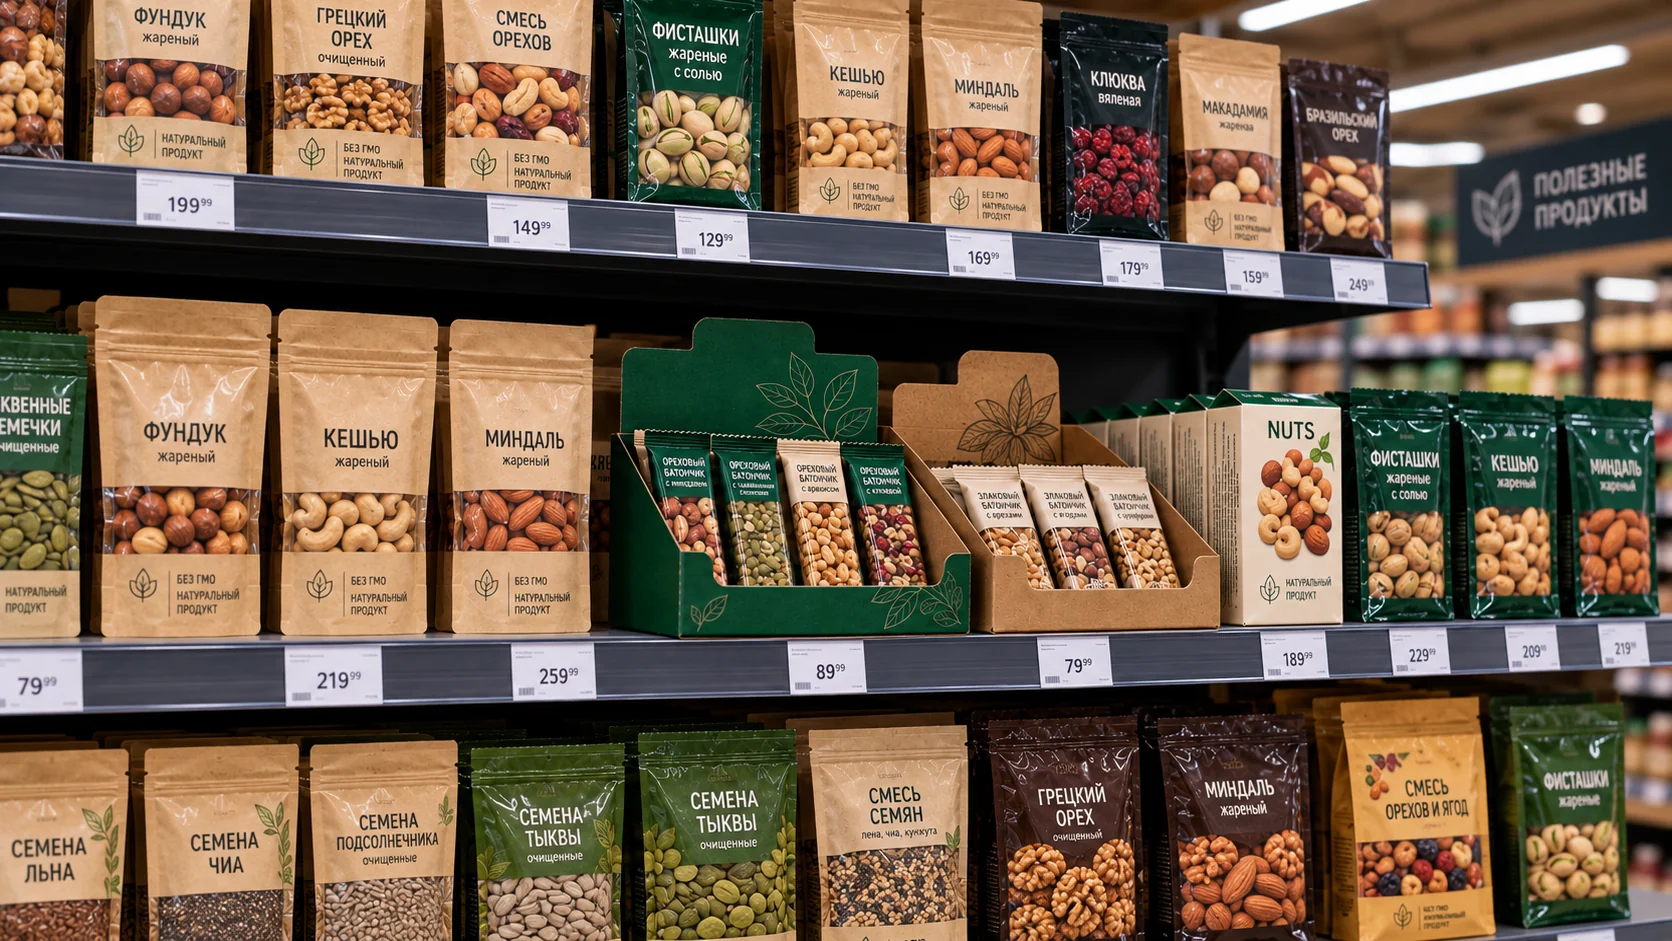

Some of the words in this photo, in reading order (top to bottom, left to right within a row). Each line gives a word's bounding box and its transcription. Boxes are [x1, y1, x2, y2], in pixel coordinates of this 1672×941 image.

[134, 7, 206, 29] ФУНДУК
[317, 7, 386, 29] ГРЕЦКИЙ
[496, 10, 547, 30] СМЕСЬ
[142, 32, 199, 46] жареный
[331, 30, 372, 49] ОРЕХ
[493, 31, 552, 50] ОРЕХОВ
[652, 21, 739, 47] ФИСТАШКИ
[318, 52, 385, 68] очищенный
[668, 48, 727, 64] жареные
[675, 69, 681, 78] с
[684, 68, 722, 81] солью
[830, 65, 884, 86] КЕШЬЮ
[1091, 70, 1146, 91] КЛЮКВА
[838, 87, 879, 100] жареный
[954, 78, 1019, 98] МИНДАЛЬ
[969, 101, 1009, 112] жареный
[1098, 93, 1141, 107] вяленая
[1202, 100, 1268, 120] МАКАДАМИЯ
[1306, 108, 1377, 129] БРАЗИЛЬСКИЙ
[162, 133, 226, 149] НАТУРАЛЬНЫЙ
[1332, 127, 1359, 143] ОРЕХ
[161, 147, 203, 160] ПРОДУКТ
[344, 143, 359, 154] БЕЗ
[362, 144, 381, 154] ГМО
[344, 157, 404, 170] НАТУРАЛЬНЫЙ
[514, 153, 529, 163] БЕЗ
[532, 154, 550, 164] ГМО
[343, 168, 383, 180] ПРОДУКТ
[514, 167, 572, 181] НАТУРАЛЬНЫЙ
[1534, 153, 1647, 197] ПОЛЕЗНЫЕ
[514, 178, 551, 191] ПРОДУКТ
[168, 196, 200, 213] 199
[201, 198, 212, 207] 99
[1535, 187, 1648, 229] ПРОДУКТЫ
[513, 219, 540, 236] 149
[541, 221, 551, 229] 99
[700, 231, 723, 247] 129
[724, 233, 733, 241] 99
[968, 250, 990, 265] 169
[991, 252, 1000, 260] 99
[1121, 261, 1141, 275] 179
[1243, 270, 1262, 284] 159
[1349, 278, 1367, 291] 249
[1, 396, 71, 416] КВЕННЫЕ
[143, 421, 226, 446] ФУНДУК
[1268, 420, 1314, 440] NUTS
[324, 428, 399, 449] КЕШЬЮ
[485, 429, 565, 451] МИНДАЛЬ
[158, 448, 215, 465] жареный
[335, 455, 389, 470] жареный
[502, 454, 550, 468] жареный
[1371, 450, 1440, 469] ФИСТАШКИ
[1491, 454, 1539, 473] КЕШЬЮ
[1590, 458, 1642, 478] МИНДАЛЬ
[1386, 473, 1431, 486] жареные
[1497, 476, 1536, 491] жареный
[1392, 491, 1397, 499] с
[1400, 490, 1428, 501] солью
[177, 574, 193, 585] БЕЗ
[197, 575, 216, 585] ГМО
[351, 576, 367, 586] БЕЗ
[369, 576, 386, 585] ГМО
[515, 576, 529, 586] БЕЗ
[531, 576, 548, 586] ГМО
[6, 584, 67, 597] НАТУРАЛЬНЫЙ
[177, 587, 240, 600] НАТУРАЛЬНЫЙ
[351, 591, 407, 603] НАТУРАЛЬНЫЙ
[515, 591, 571, 603] НАТУРАЛЬНЫЙ
[1286, 590, 1316, 600] ПРОДУКТ
[6, 602, 46, 614] ПРОДУКТ
[177, 603, 218, 616] ПРОДУКТ
[351, 605, 387, 616] ПРОДУКТ
[515, 605, 551, 615] ПРОДУКТ
[1409, 649, 1429, 663] 229
[1523, 645, 1540, 659] 209
[1615, 642, 1630, 656] 219
[1065, 658, 1083, 673] 79
[1083, 658, 1092, 666] 99
[1283, 652, 1304, 667] 189
[540, 668, 568, 684] 259
[569, 668, 578, 676] 99
[816, 664, 835, 679] 89
[835, 664, 846, 672] 99
[18, 678, 43, 696] 79
[317, 671, 349, 689] 219
[1405, 779, 1449, 797] СМЕСЬ
[1544, 770, 1609, 790] ФИСТАШКИ
[869, 785, 921, 805] СМЕСЬ
[1038, 782, 1106, 806] ГРЕЦКИЙ
[1204, 778, 1275, 799] МИНДАЛЬ
[690, 790, 759, 810] СЕМЕНА
[520, 806, 583, 826] СЕМЕНА
[870, 806, 923, 824] СЕМЯН
[1220, 801, 1267, 817] жареный
[1386, 802, 1429, 821] ОРЕХОВ
[1431, 801, 1440, 816] И
[1442, 799, 1469, 818] ЯГОД
[359, 812, 418, 830] СЕМЕНА
[696, 813, 757, 833] ТЫКВЫ
[1056, 808, 1095, 827] ОРЕХ
[191, 832, 259, 852] СЕМЕНА
[336, 832, 439, 852] ПОДСОЛНЕЧНИКА
[525, 828, 581, 847] ТЫКВЫ
[700, 838, 758, 850] очищенные
[1053, 829, 1103, 843] очищенный
[11, 837, 86, 858] СЕМЕНА
[209, 856, 244, 874] ЧИА
[362, 853, 417, 865] очищенные
[527, 851, 583, 863] очищенные
[25, 863, 75, 883] ЛЬНА
